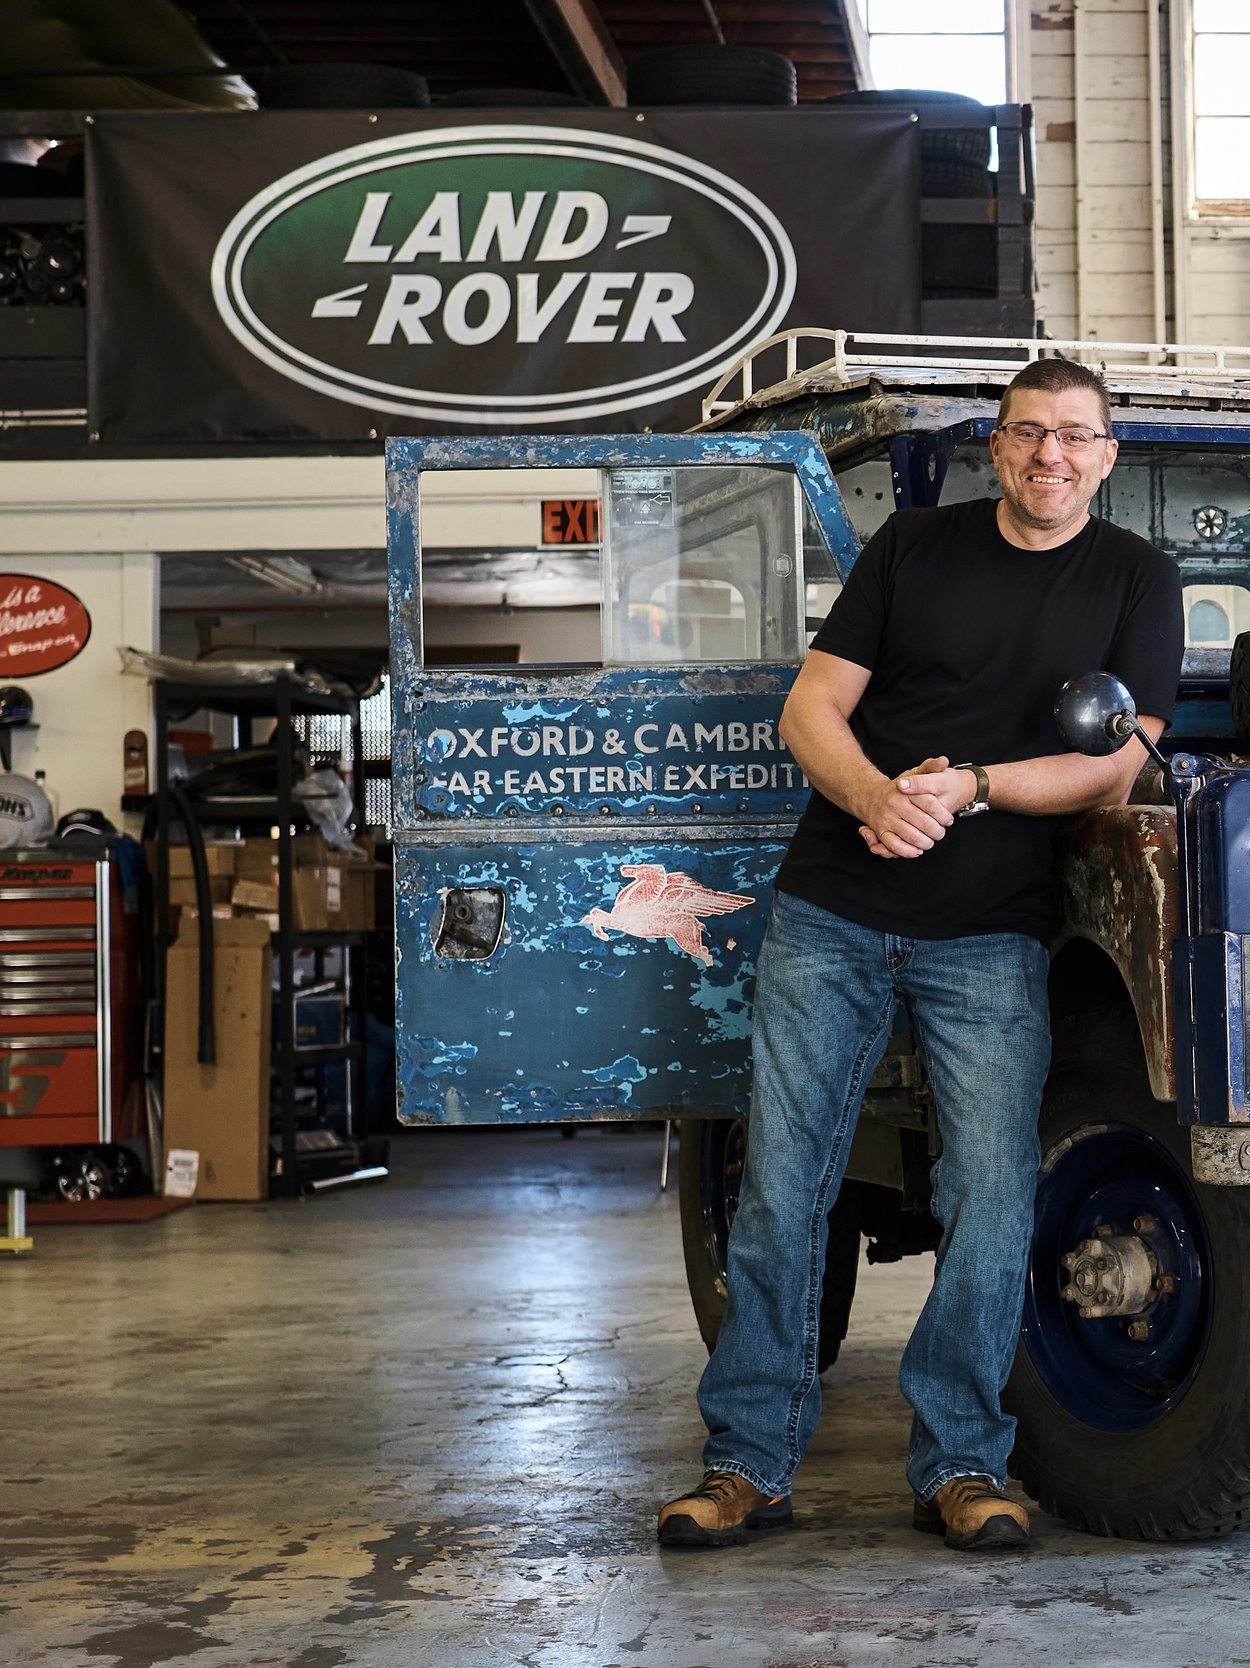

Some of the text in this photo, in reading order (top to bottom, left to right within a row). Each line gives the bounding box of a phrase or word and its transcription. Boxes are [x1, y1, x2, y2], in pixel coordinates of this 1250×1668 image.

[343, 190, 609, 264] LAND
[367, 271, 695, 346] ROVER
[427, 726, 594, 759] OXFORD
[602, 727, 628, 755] &
[504, 765, 654, 796] EASTERN
